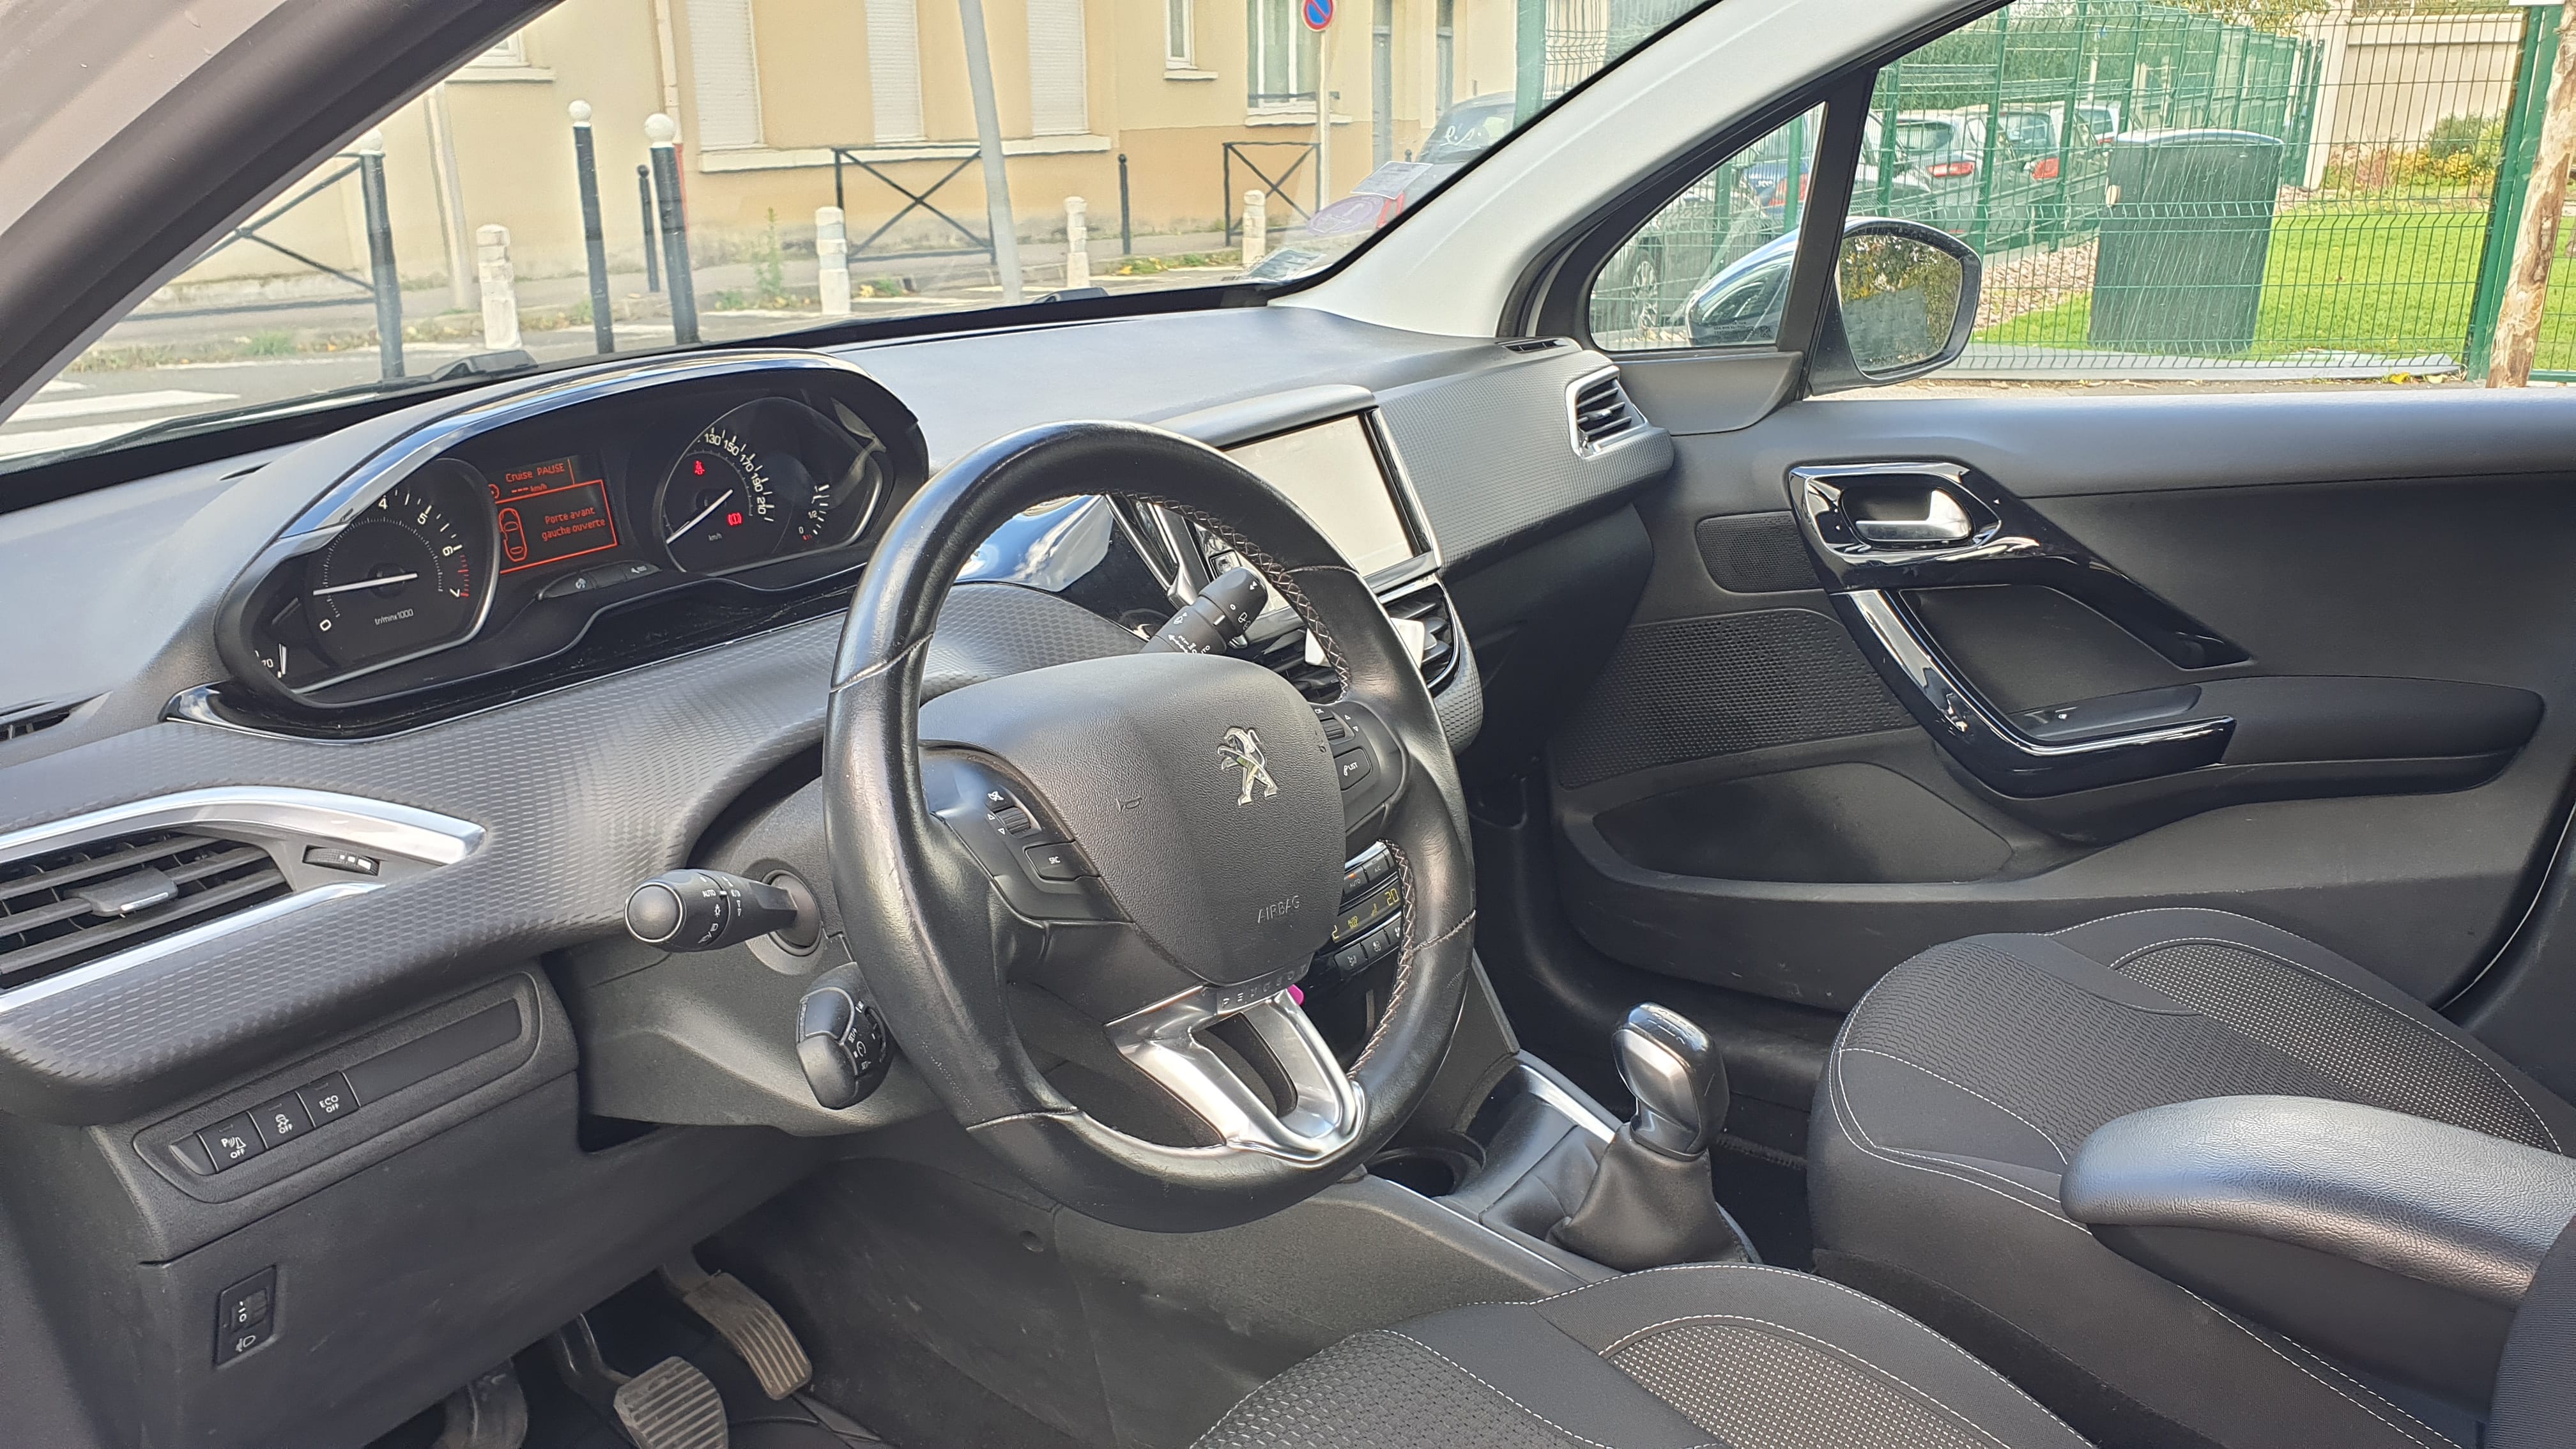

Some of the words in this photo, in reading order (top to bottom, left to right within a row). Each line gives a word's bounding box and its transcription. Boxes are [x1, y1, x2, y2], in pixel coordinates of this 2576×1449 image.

[704, 433, 721, 446] 130
[724, 440, 739, 456] 150
[740, 454, 754, 472] 170
[506, 470, 533, 482] Cruise
[537, 463, 565, 476] PAUSE
[751, 473, 763, 492] 190
[378, 498, 388, 509] 4
[757, 496, 767, 515] 210
[417, 512, 428, 525] 5
[545, 514, 568, 525] Porte
[571, 507, 595, 518] avant
[542, 525, 571, 542] gauche
[572, 519, 606, 532] ouverte
[442, 546, 453, 556] 6
[450, 588, 460, 597] 7
[319, 618, 332, 631] 0
[1348, 762, 1358, 770] LIST
[1349, 878, 1361, 888] AUTO
[702, 889, 716, 898] AUTO
[1384, 888, 1400, 906] 20
[1257, 895, 1300, 924] AIRBAG
[319, 1095, 339, 1108] ECO
[326, 1103, 339, 1113] OFF
[279, 1123, 293, 1134] OFF
[230, 1149, 245, 1159] OFF
